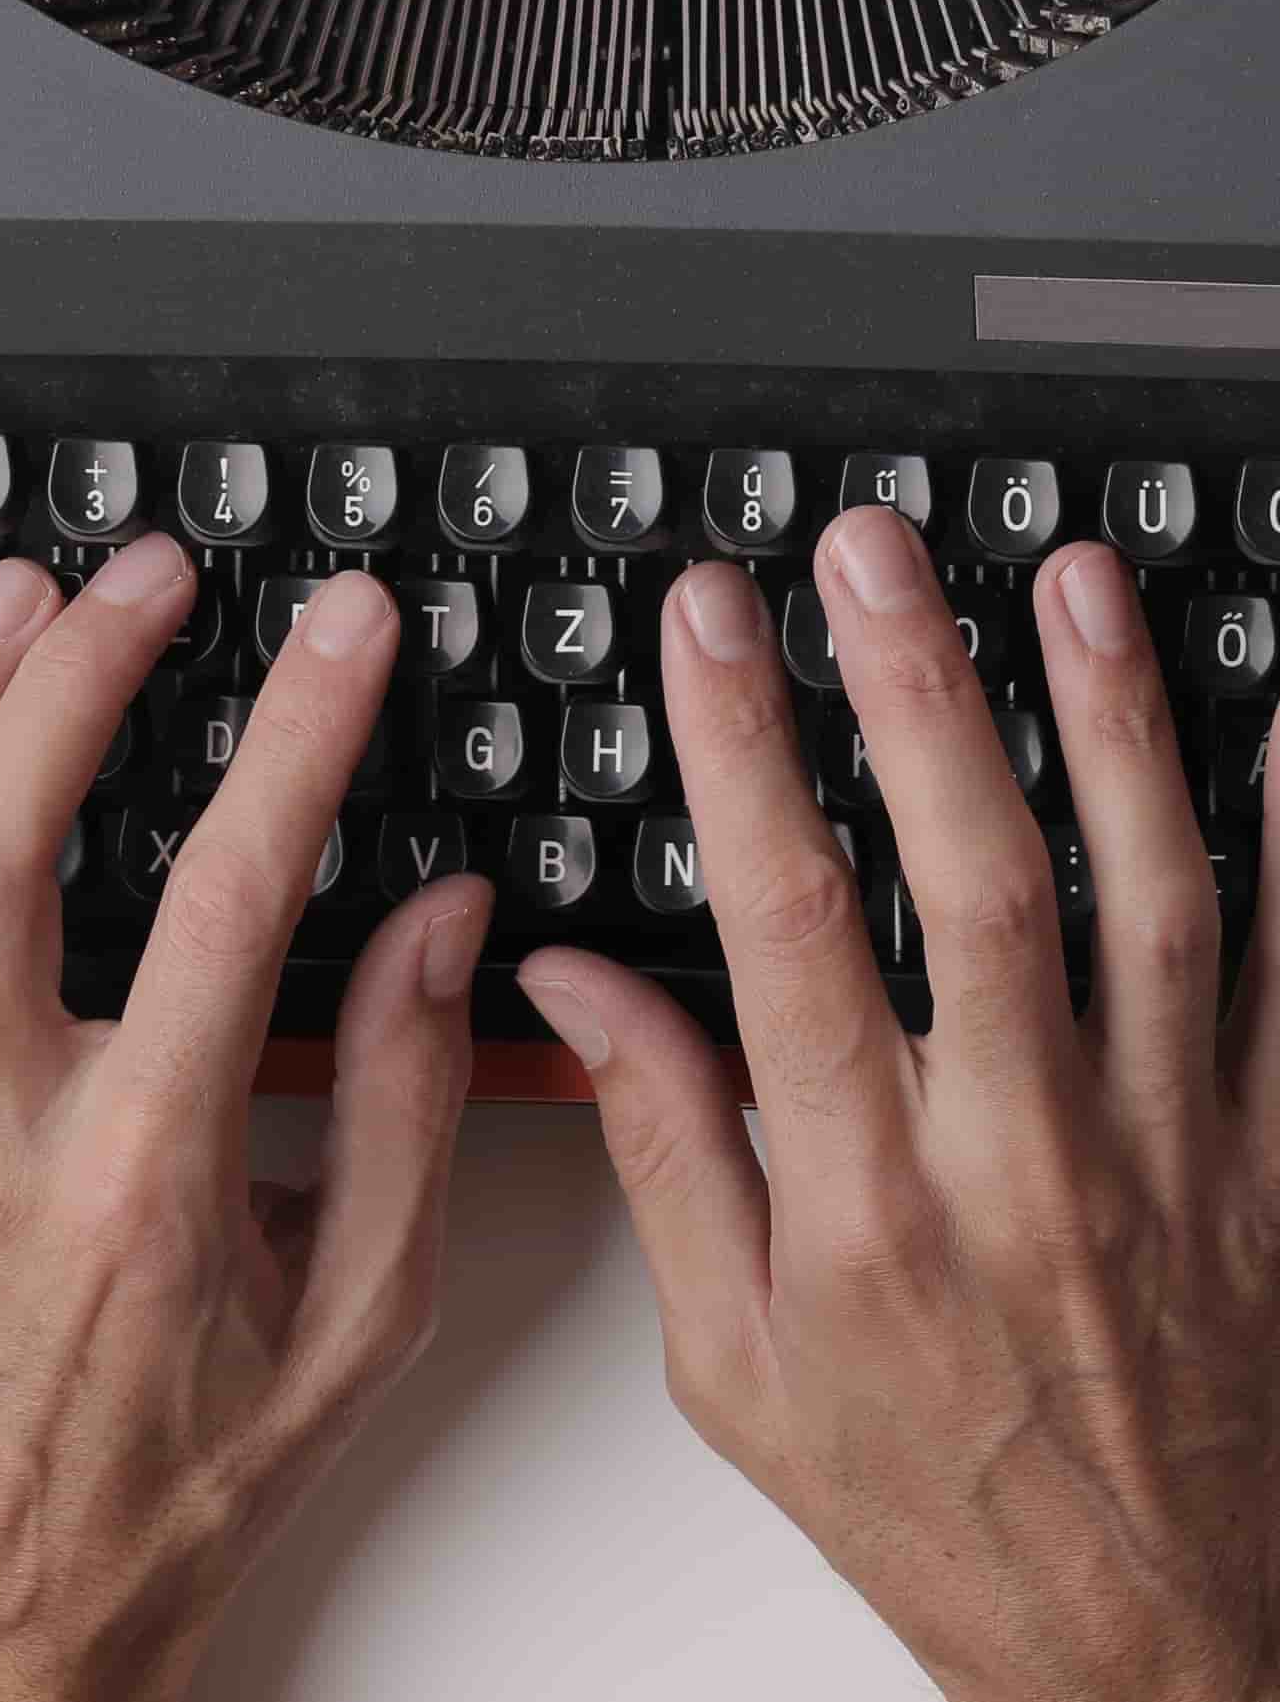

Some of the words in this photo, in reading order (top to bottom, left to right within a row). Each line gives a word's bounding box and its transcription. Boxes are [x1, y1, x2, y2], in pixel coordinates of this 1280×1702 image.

[84, 460, 108, 484] +
[219, 456, 229, 491] !
[341, 460, 370, 492] %
[474, 462, 498, 489] /
[609, 470, 633, 485] =
[743, 465, 762, 498] ú
[85, 489, 105, 522] 3
[214, 492, 233, 524] 4
[344, 495, 364, 527] 5
[473, 495, 493, 527] 6
[609, 496, 632, 529] 7
[741, 500, 763, 532] 8
[1002, 477, 1032, 532] Ö
[1138, 480, 1167, 534] Ü
[421, 605, 450, 649] T
[555, 609, 585, 653] Z
[1217, 612, 1247, 668] Ő
[206, 719, 234, 765] D
[465, 726, 493, 771] G
[592, 728, 622, 773] H
[148, 830, 180, 873] X
[408, 836, 441, 880] V
[539, 840, 566, 883] B
[664, 842, 694, 886] N
